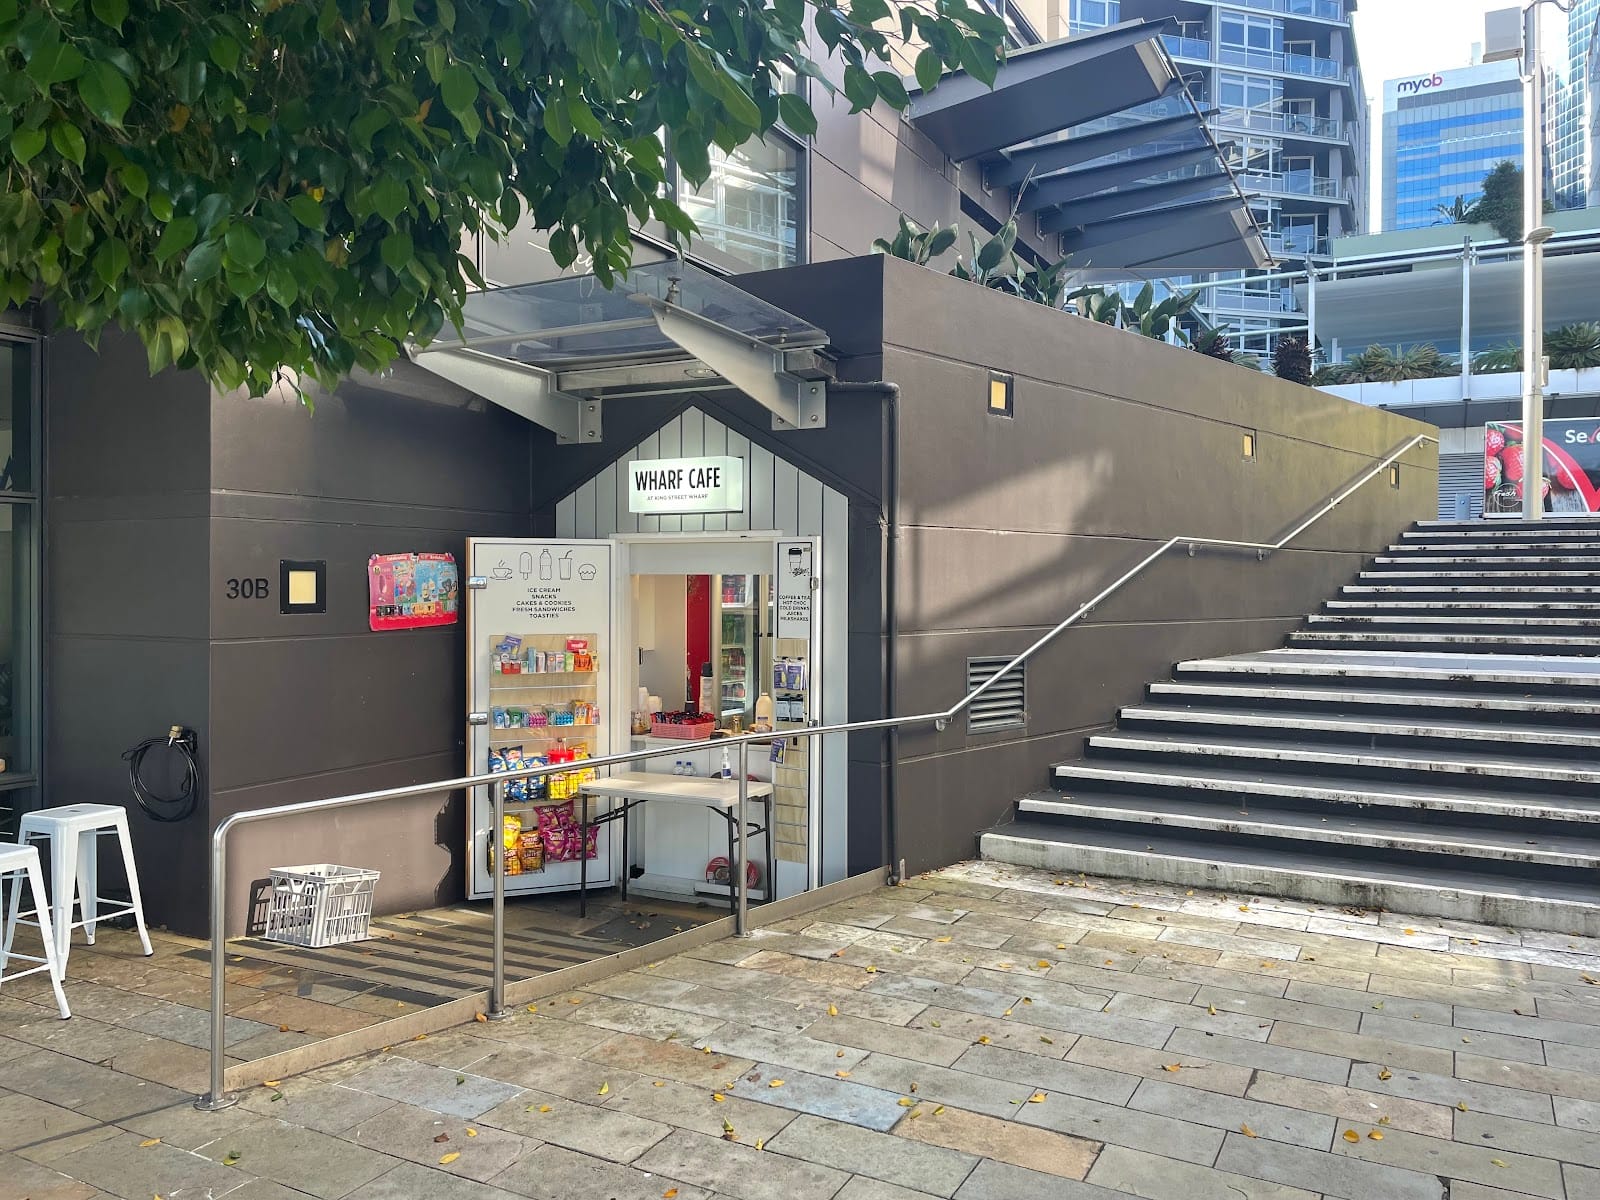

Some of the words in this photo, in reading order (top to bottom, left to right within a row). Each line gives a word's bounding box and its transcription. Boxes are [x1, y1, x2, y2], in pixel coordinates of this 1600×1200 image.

[1397, 73, 1443, 94] myob
[635, 469, 683, 491] WHARF
[688, 467, 721, 489] CAFE
[226, 578, 270, 600] 30B
